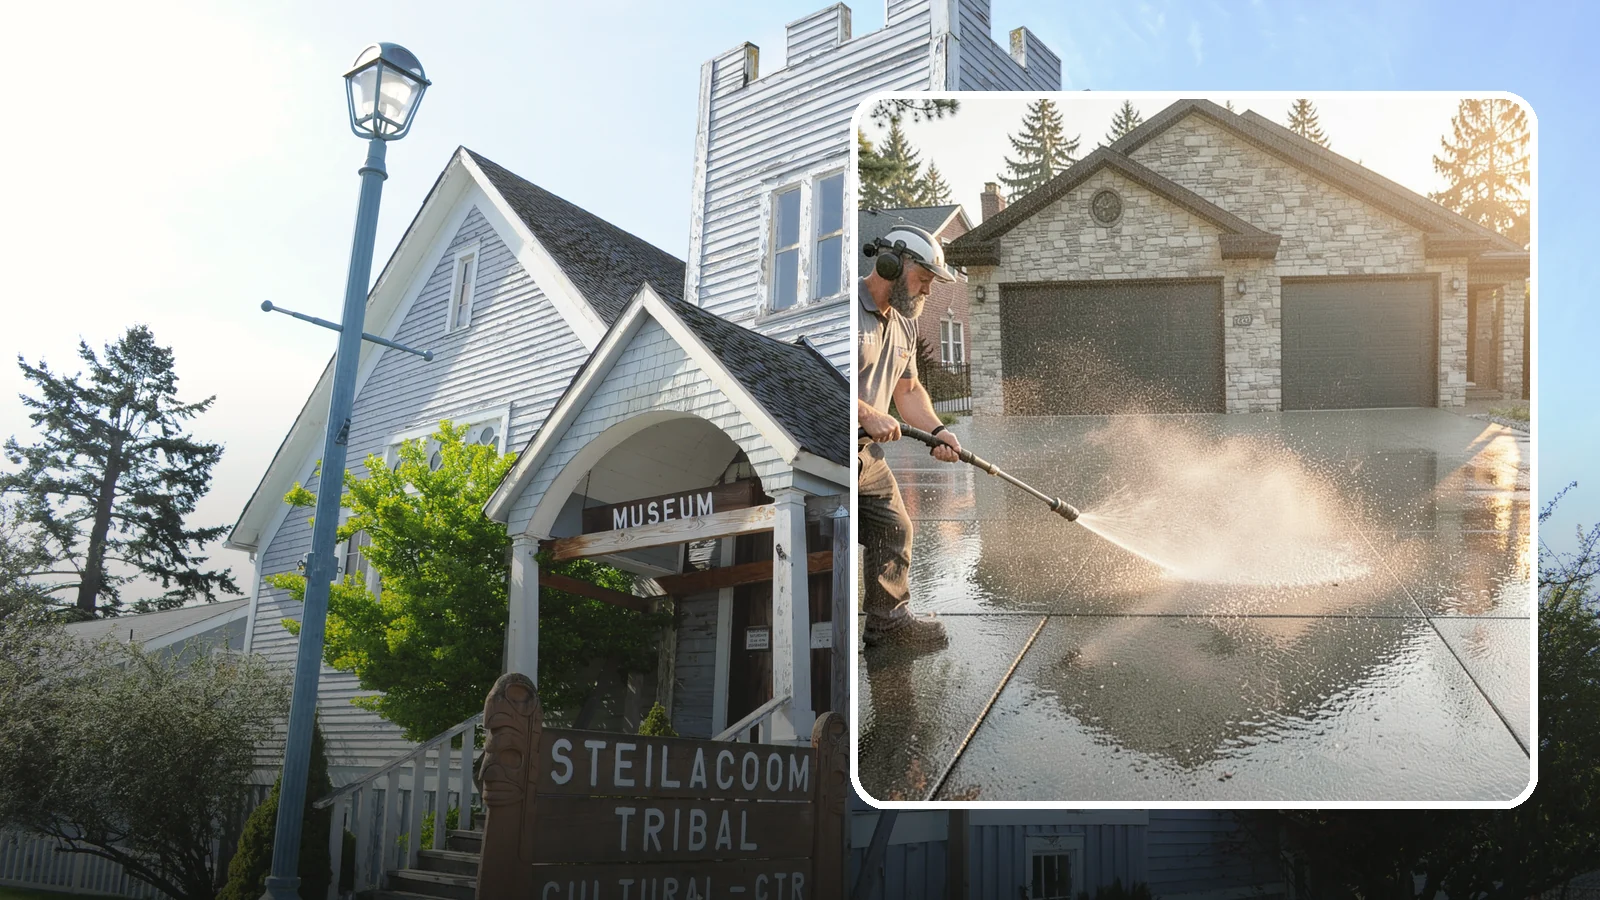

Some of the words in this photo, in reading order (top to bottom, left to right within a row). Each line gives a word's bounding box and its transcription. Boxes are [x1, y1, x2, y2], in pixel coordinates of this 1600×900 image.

[612, 491, 714, 531] MUSEUM
[550, 738, 810, 793] STEILACOOM
[614, 806, 758, 852] TRIBAL
